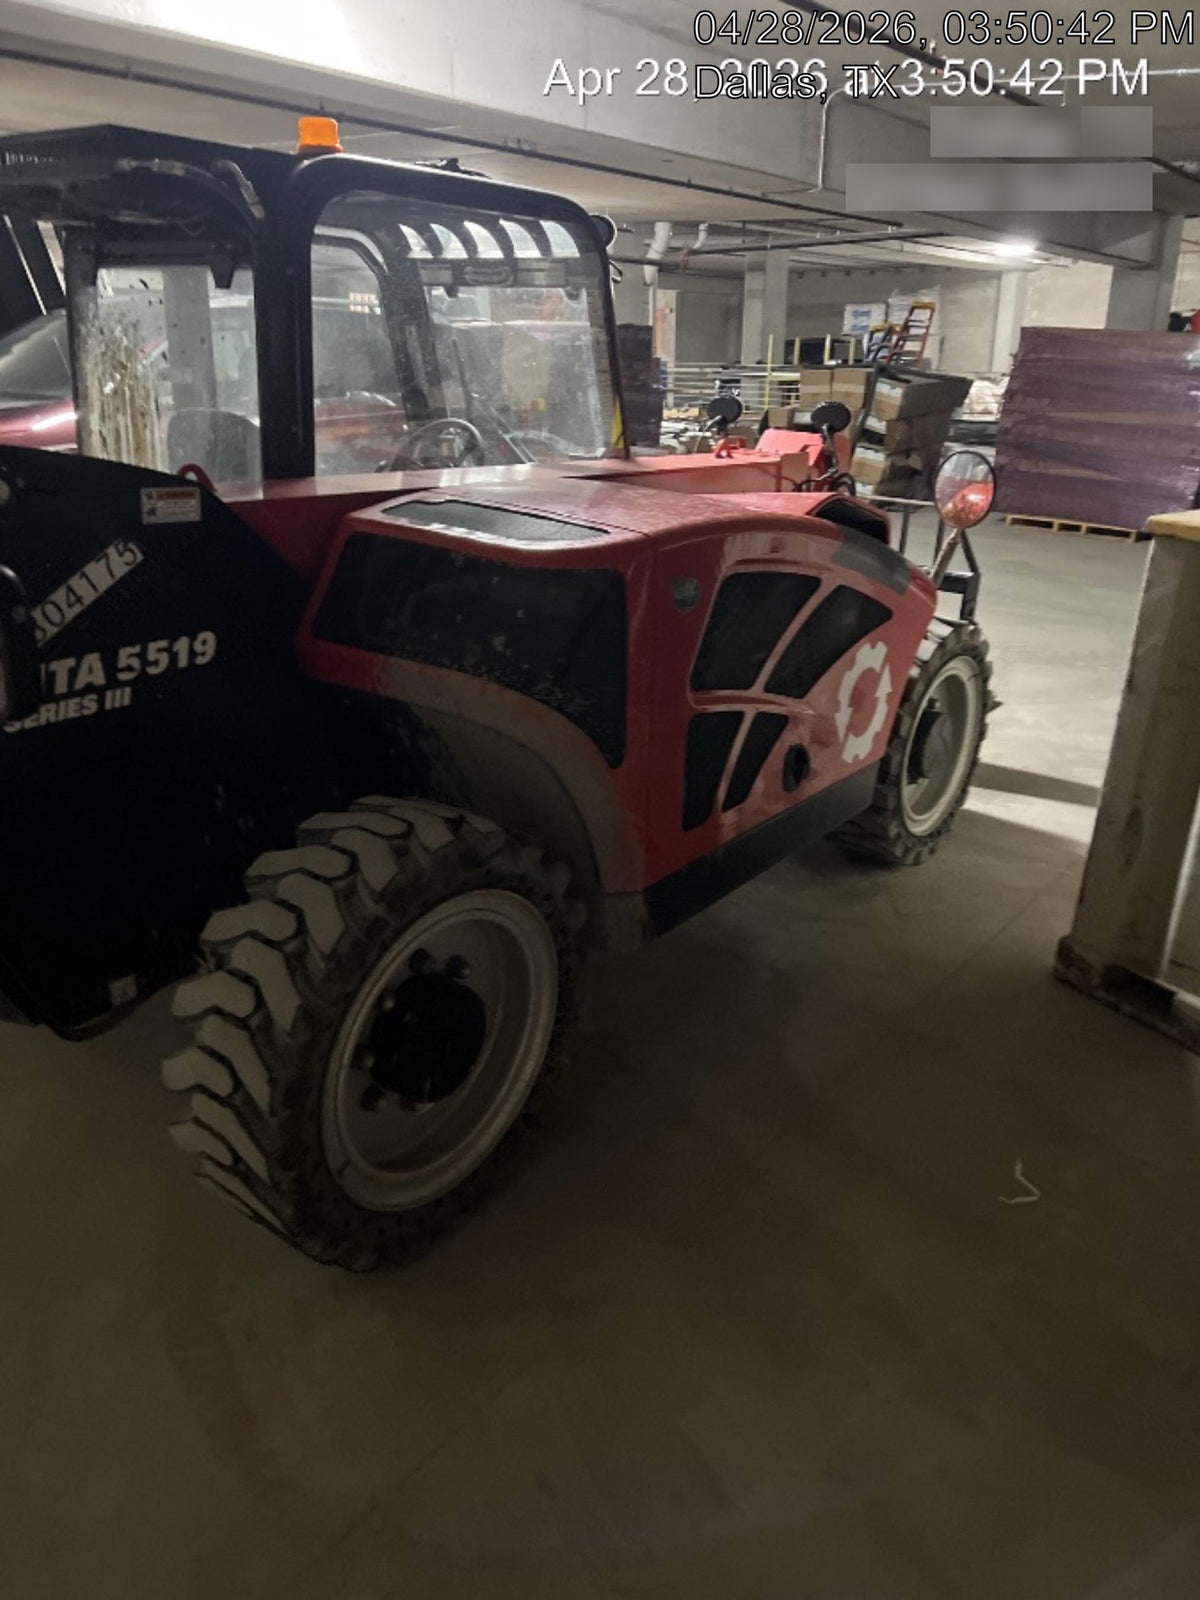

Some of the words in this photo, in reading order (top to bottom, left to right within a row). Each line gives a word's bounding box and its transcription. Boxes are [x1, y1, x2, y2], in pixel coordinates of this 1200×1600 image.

[41, 652, 107, 696] TA
[115, 630, 218, 682] 5519
[104, 685, 132, 711] III
